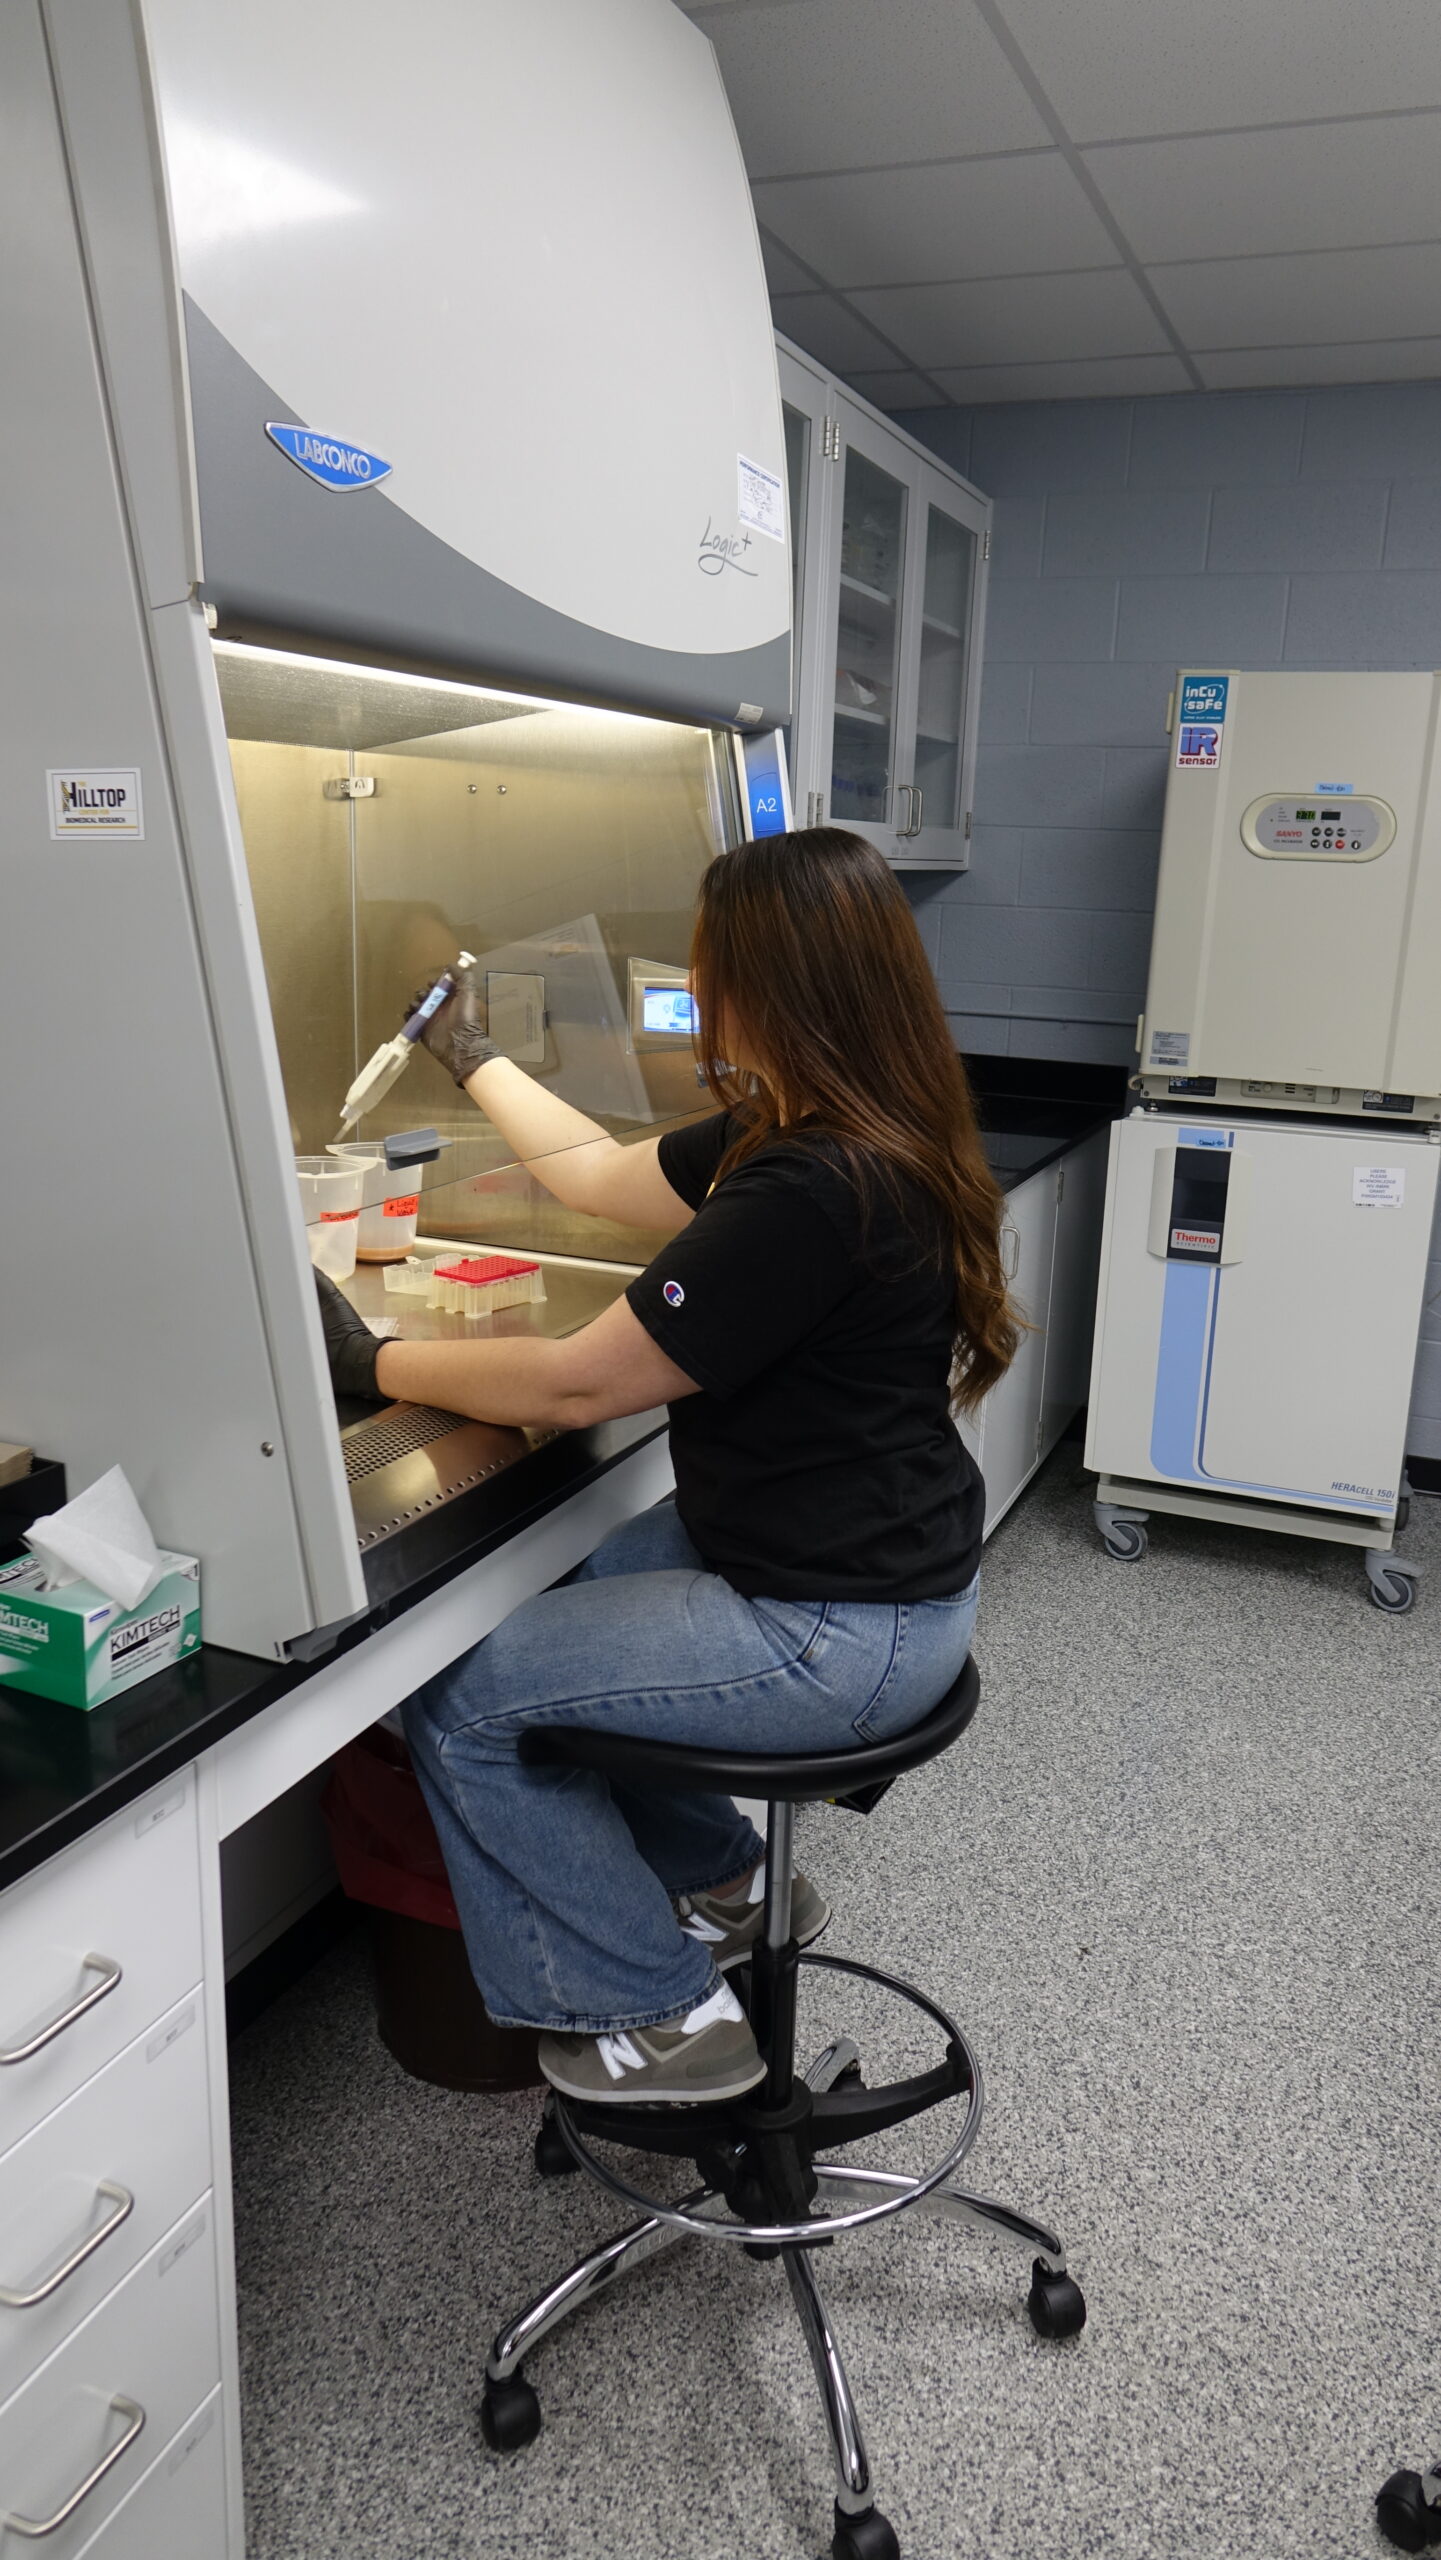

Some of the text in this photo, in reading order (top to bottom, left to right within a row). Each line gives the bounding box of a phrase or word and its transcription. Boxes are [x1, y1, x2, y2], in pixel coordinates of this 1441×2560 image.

[294, 433, 371, 479] LABCONCO
[1185, 685, 1217, 697] inCu
[1187, 699, 1223, 710] saFe
[1180, 727, 1218, 756] IR
[1178, 757, 1218, 766] sensor
[756, 797, 777, 814] A2
[1175, 1231, 1216, 1244] Thermo
[1331, 1481, 1396, 1499] HERACELL 150i
[0, 1610, 49, 1635] MTECH
[111, 1604, 180, 1653] KIMTECH
